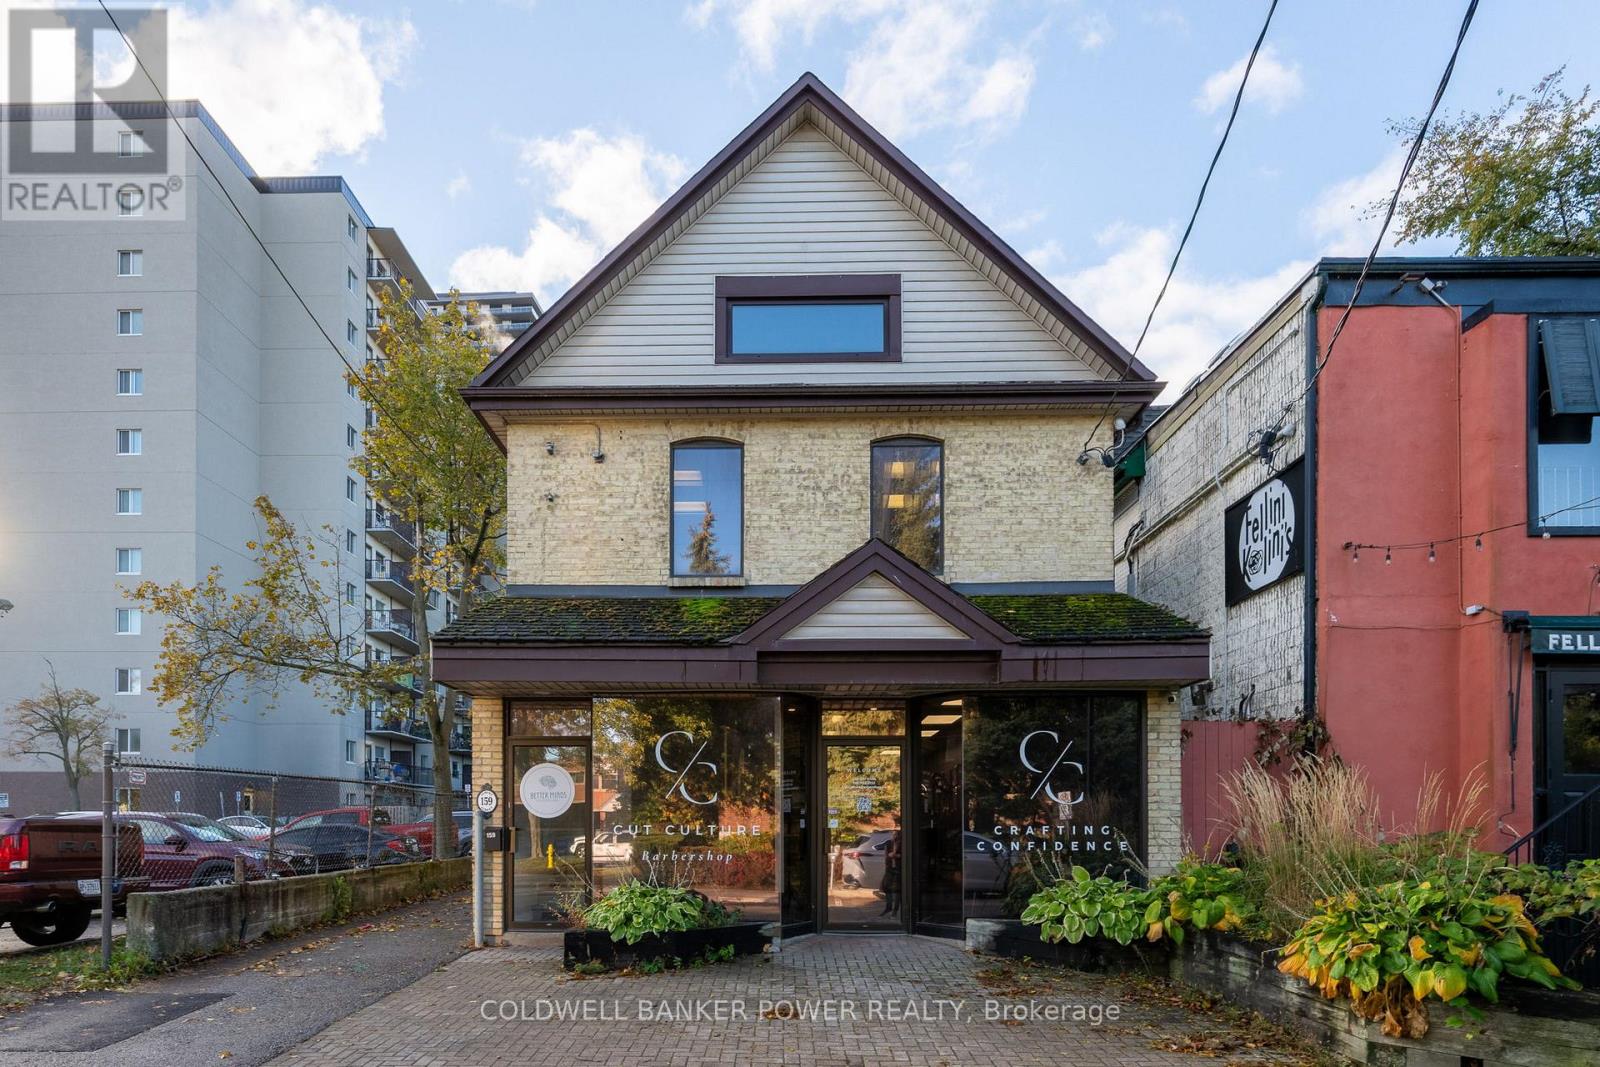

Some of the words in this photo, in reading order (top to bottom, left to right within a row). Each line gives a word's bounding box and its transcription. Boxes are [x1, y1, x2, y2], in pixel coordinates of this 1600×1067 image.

[1245, 481, 1285, 545] Fellini
[1549, 634, 1600, 650] FELL
[481, 796, 493, 806] 159
[613, 824, 652, 836] CUT
[665, 824, 761, 836] CULTURE
[994, 825, 1110, 836] CRAFTING
[976, 841, 1129, 851] CONFIDENCE
[642, 850, 734, 864] Barbershop
